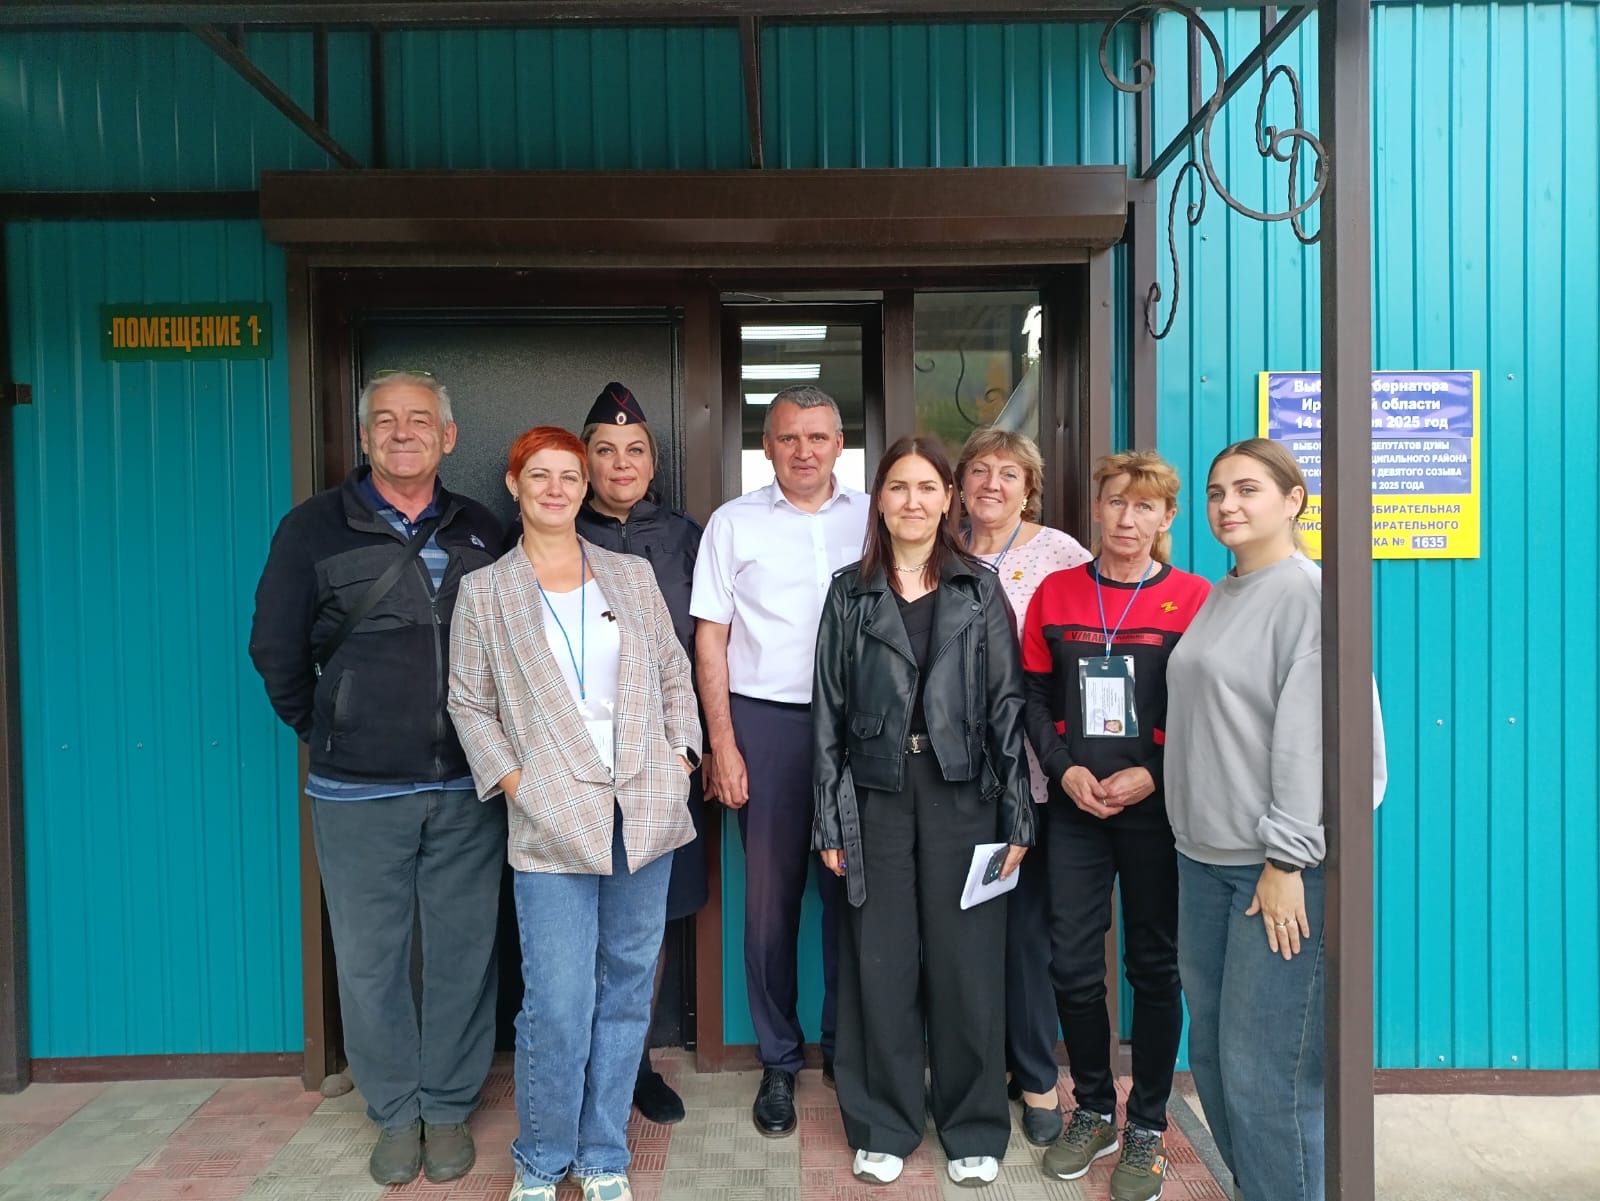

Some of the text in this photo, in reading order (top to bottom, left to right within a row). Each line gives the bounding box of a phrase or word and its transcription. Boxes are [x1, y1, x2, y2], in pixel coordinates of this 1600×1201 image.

[112, 315, 259, 352] ПОМЕЩЕНИЕ 1
[1294, 380, 1449, 394] Выб бернатора
[1382, 398, 1441, 410] области
[1295, 416, 1312, 428] 14
[1386, 416, 1420, 428] 2025
[1423, 418, 1449, 430] год
[1293, 442, 1321, 451] ВЫБО
[1423, 441, 1449, 451] ДУМЫ
[1372, 453, 1468, 463] ЦИПАЛЬНОГО РАЙОНА
[1377, 468, 1424, 478] ДЕВЯТОГО
[1425, 468, 1462, 476] СОЗЫВА
[1378, 481, 1399, 490] 2025
[1401, 481, 1425, 491] ГОДА
[1371, 504, 1461, 514] ЗБИРАТЕЛЬНАЯ
[1374, 520, 1459, 530] ИРАТЕЛЬНОГО
[1392, 537, 1405, 546] №
[1414, 537, 1445, 548] 1635
